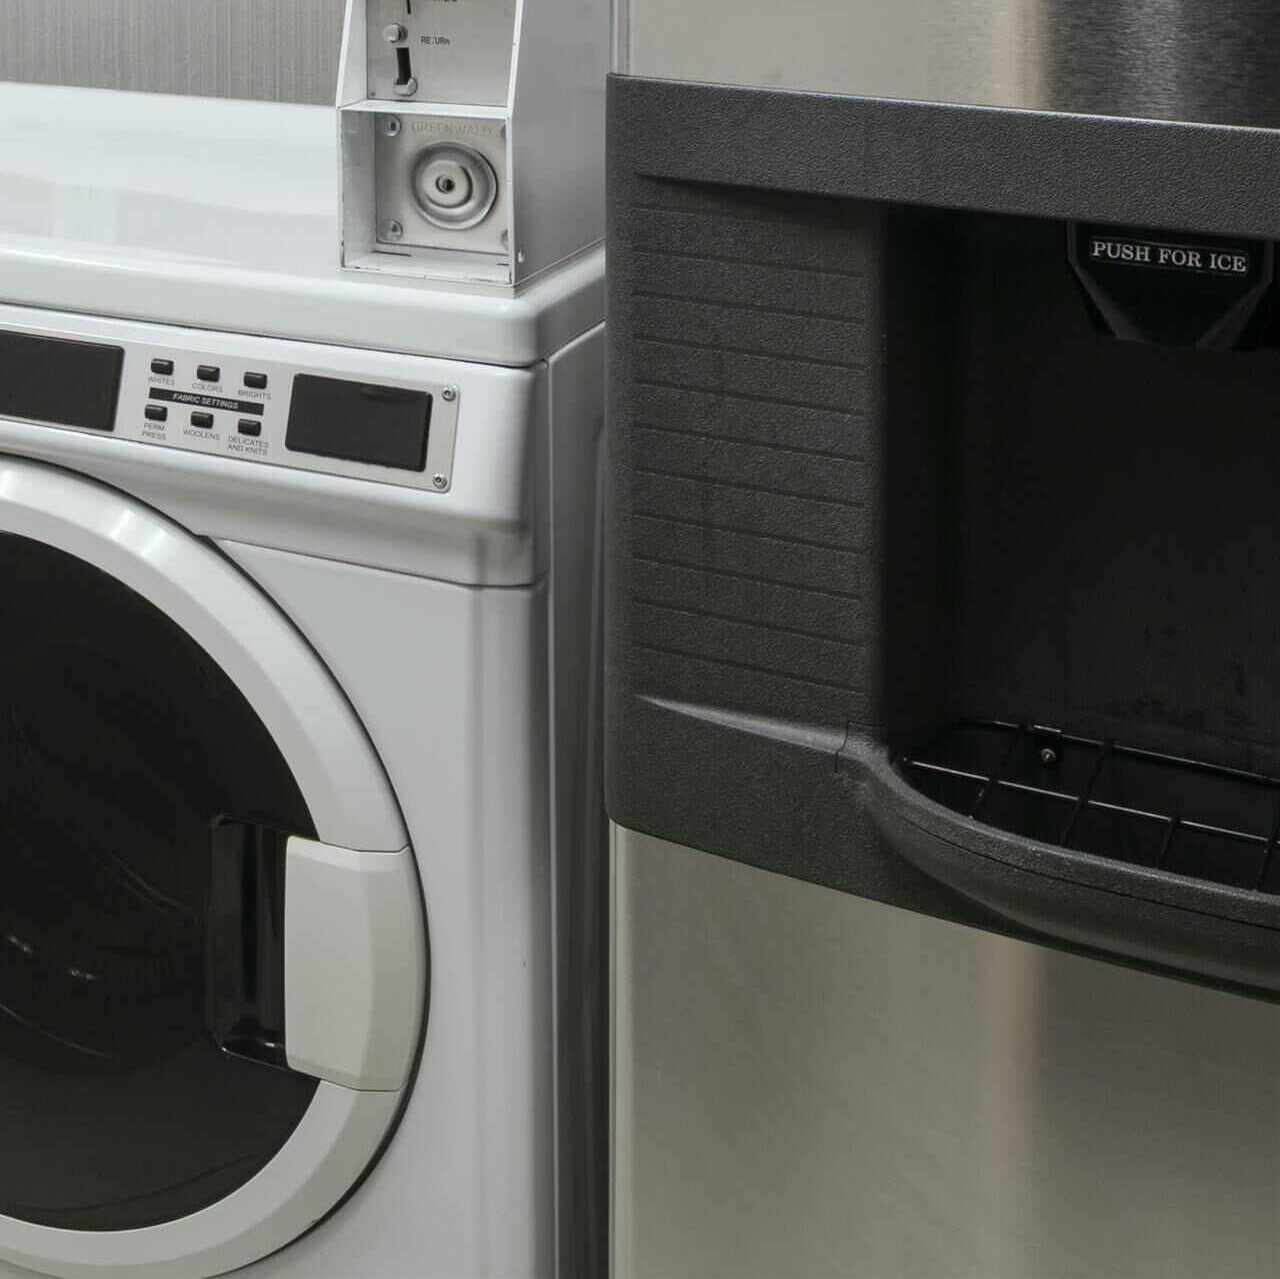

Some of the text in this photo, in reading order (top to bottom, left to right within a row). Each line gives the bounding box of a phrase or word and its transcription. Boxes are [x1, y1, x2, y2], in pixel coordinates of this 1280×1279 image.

[410, 121, 492, 137] GREENWALD
[1092, 240, 1248, 273] PUSH FOR ICE
[147, 376, 176, 387] WHITES
[191, 382, 223, 394] COLORS
[172, 392, 239, 410] FABRIC SETTINGS
[238, 389, 272, 401] BRIGHTS
[143, 422, 165, 432] PERM
[142, 431, 167, 441] PRESS
[183, 429, 220, 441] WOOLENS
[228, 435, 270, 449] DELICATES
[227, 444, 268, 456] AND KNITS
